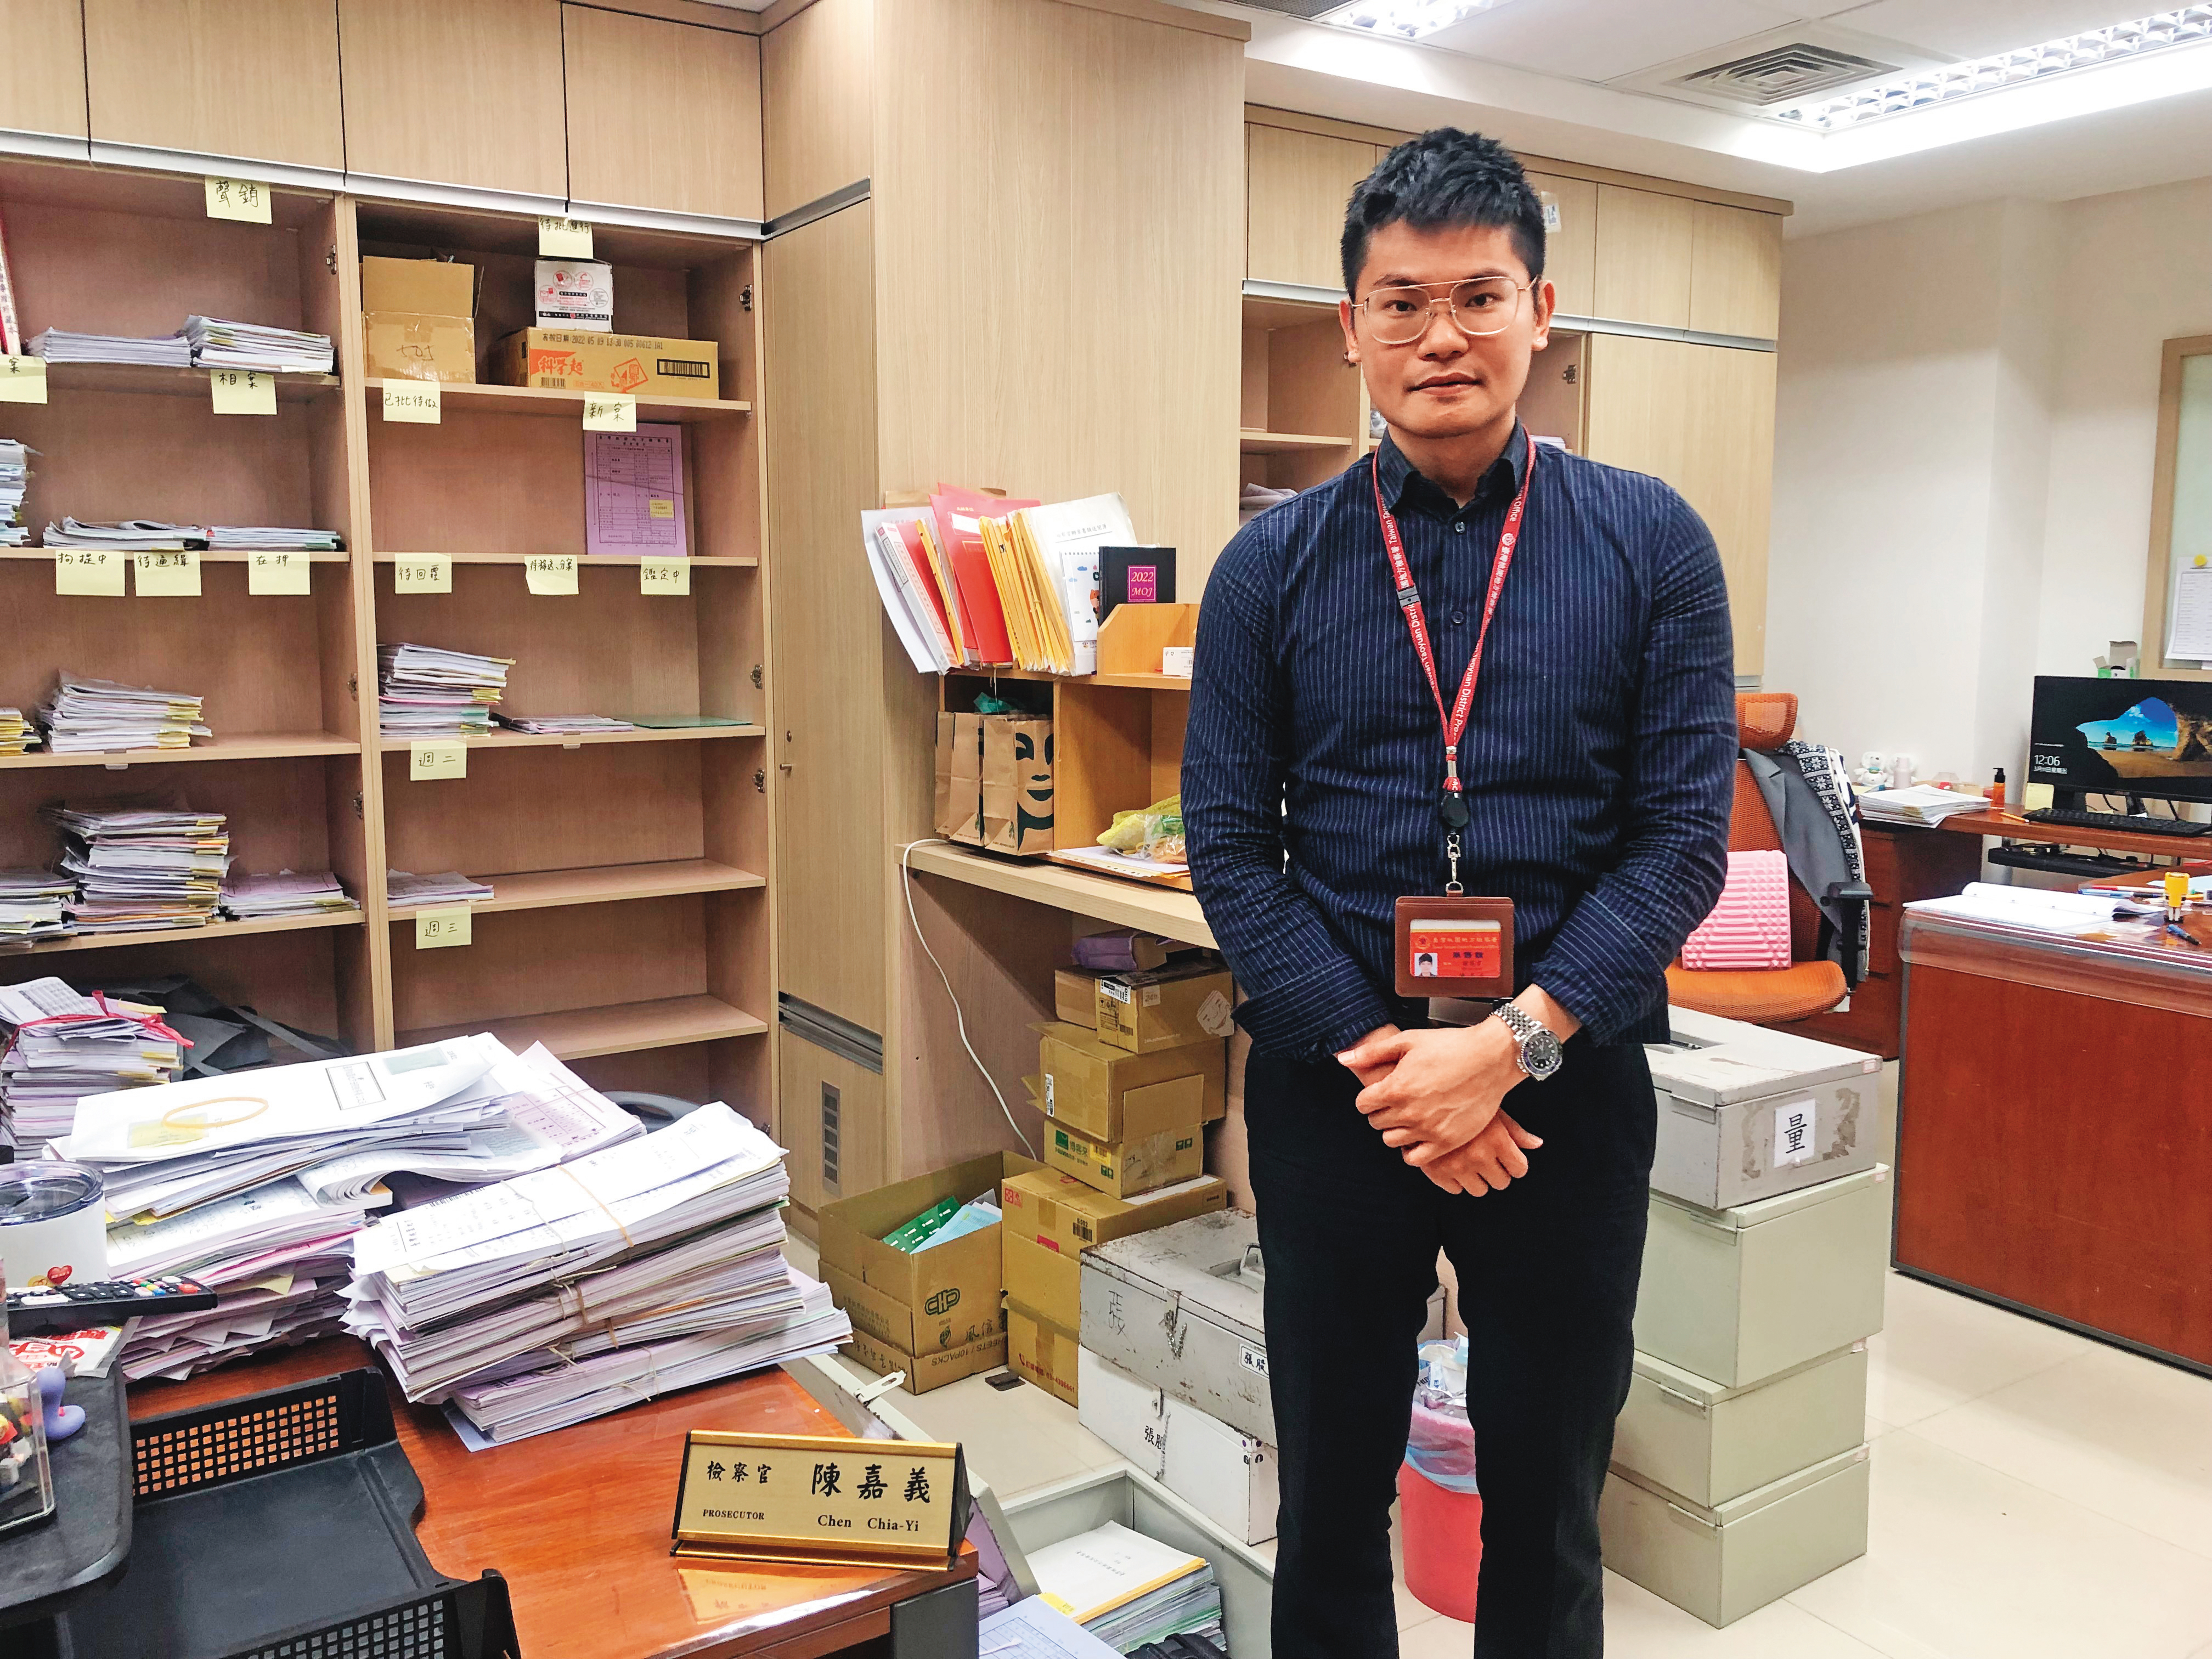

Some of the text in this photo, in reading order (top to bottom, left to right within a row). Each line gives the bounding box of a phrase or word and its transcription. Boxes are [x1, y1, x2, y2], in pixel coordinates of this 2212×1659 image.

[219, 373, 258, 390] 相案
[589, 401, 624, 422] 新案
[1509, 500, 1522, 522] Office
[1388, 518, 1399, 544] Taiwan
[58, 552, 106, 565] 拘提中
[256, 555, 289, 567] 在押
[643, 567, 680, 584] 鑑定中
[1131, 572, 1154, 582] 2022
[1132, 587, 1154, 597] MOJ
[1413, 629, 1430, 662] Taoyuan
[1455, 686, 1472, 718] District
[419, 752, 456, 767] 週二
[2034, 755, 2061, 766] 12:06
[425, 921, 458, 937] 週三
[1784, 1113, 1808, 1154] 量
[931, 1348, 969, 1367] 10PACKS
[707, 1460, 772, 1484] 檢察官
[811, 1463, 931, 1504] 陳嘉義
[702, 1509, 765, 1520] PROSECUTOR
[817, 1515, 919, 1532] Chen Chia-Yi
